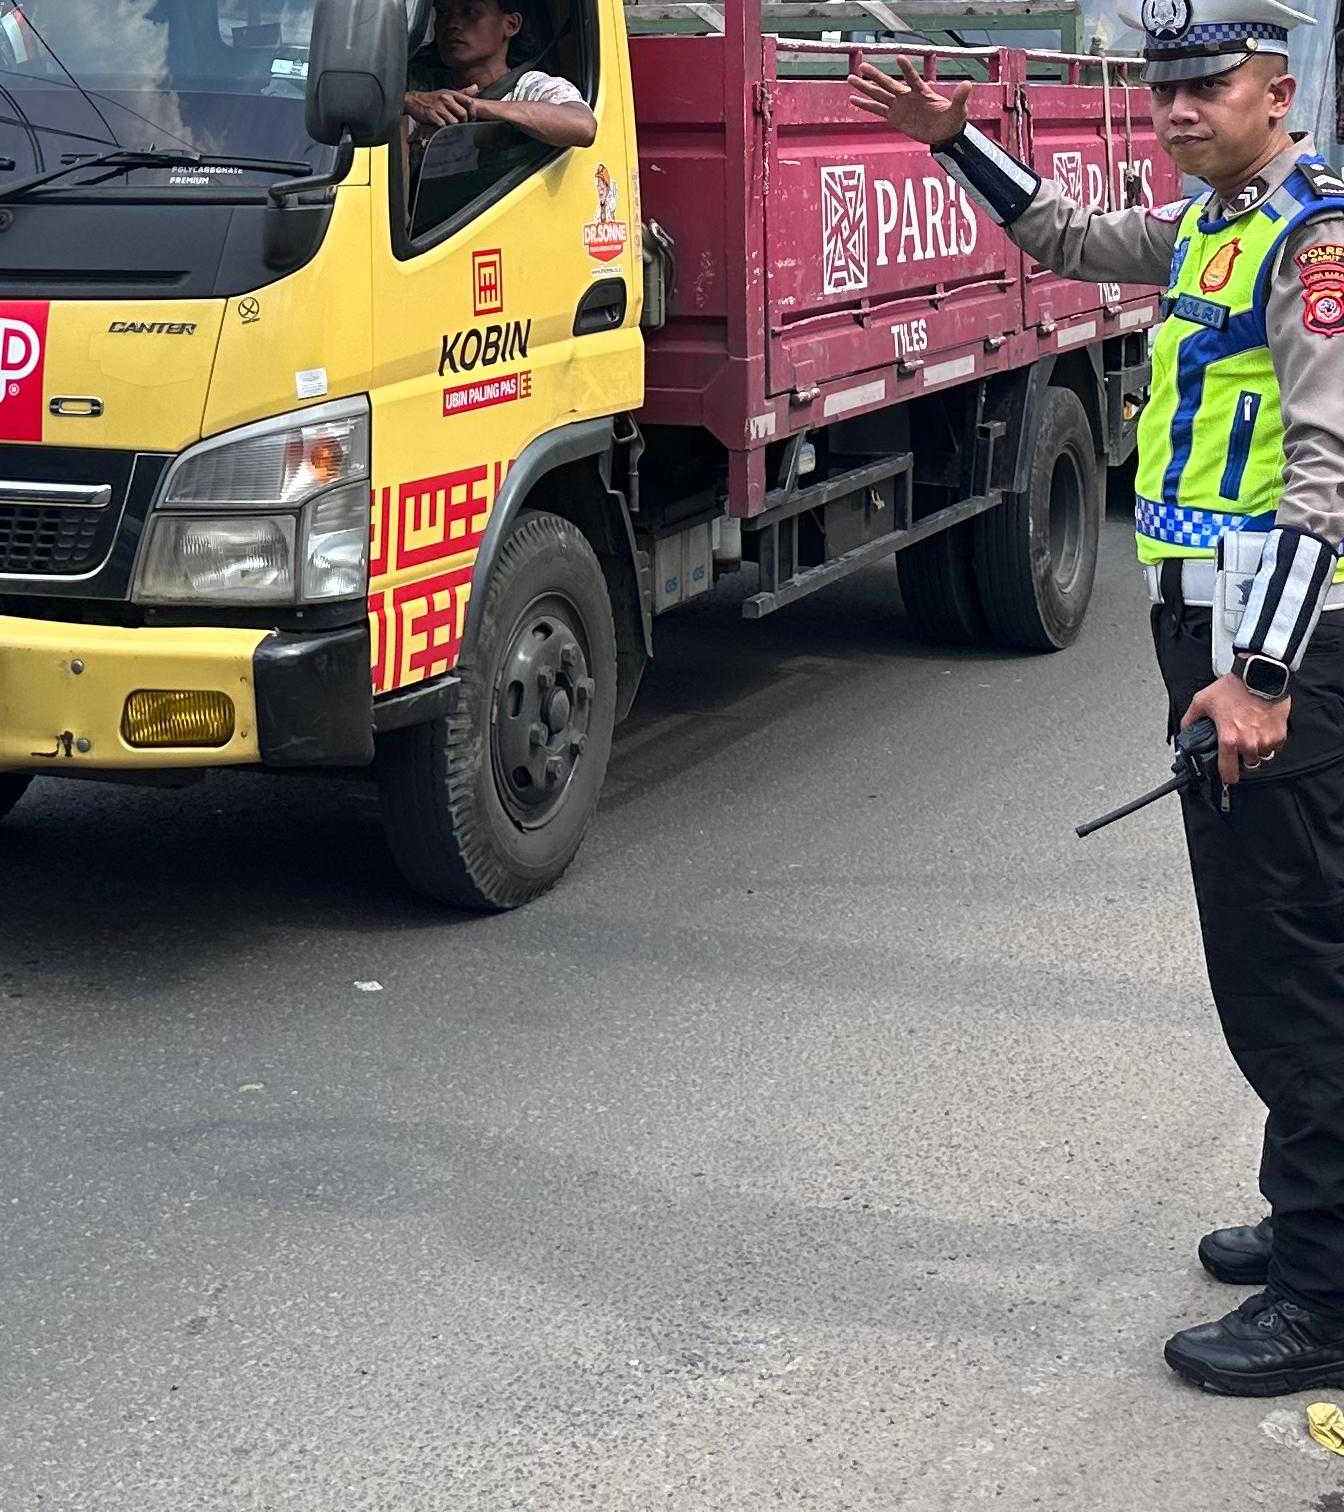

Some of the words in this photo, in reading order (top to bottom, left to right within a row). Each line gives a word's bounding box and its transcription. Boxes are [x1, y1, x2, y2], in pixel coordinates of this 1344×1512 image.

[169, 176, 210, 185] PREMIUM
[584, 223, 627, 245] DR.SONNE
[873, 175, 978, 266] PARIS
[1176, 295, 1221, 324] POLRI
[107, 320, 198, 337] CANTER
[890, 318, 929, 358] TILES
[437, 318, 532, 377] KOBIN
[444, 389, 469, 409] UBIN
[469, 383, 501, 406] PALING
[500, 378, 517, 397] PAS
